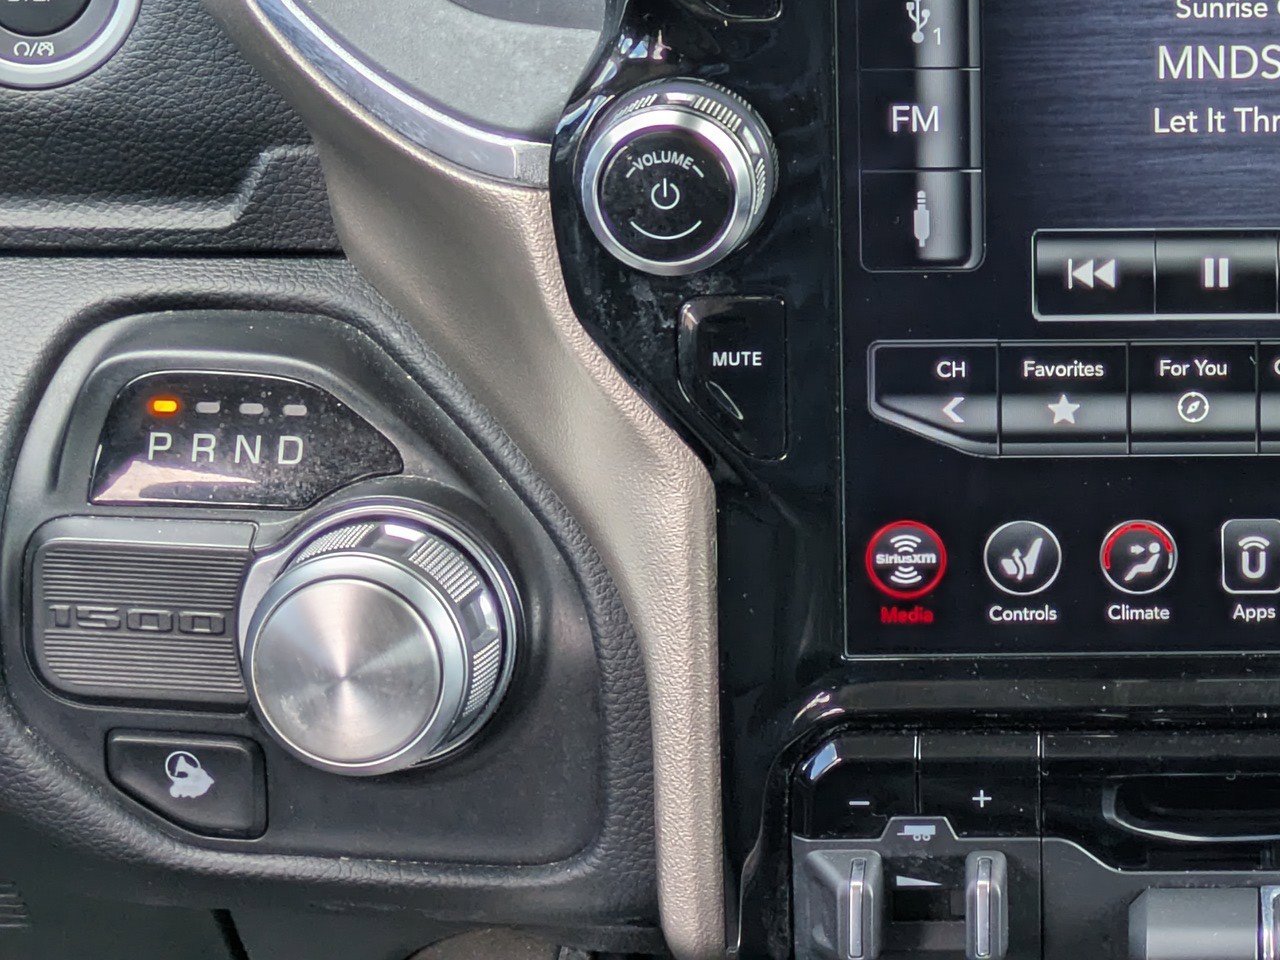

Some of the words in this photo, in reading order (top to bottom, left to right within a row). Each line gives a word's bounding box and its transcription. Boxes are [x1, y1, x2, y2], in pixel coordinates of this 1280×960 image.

[891, 105, 940, 132] FM
[1153, 107, 1198, 133] Let
[1207, 107, 1225, 133] It
[631, 150, 694, 172] VOLUME
[711, 351, 763, 367] MUTE
[1023, 359, 1104, 378] Favorites
[1159, 359, 1190, 377] For
[1194, 359, 1228, 377] You
[936, 360, 966, 379] CH
[148, 432, 173, 460] P
[191, 433, 216, 463] R
[234, 434, 261, 463] N
[277, 435, 304, 464] D
[50, 603, 226, 634] 1500
[880, 608, 934, 623] Media
[989, 605, 1057, 622] Controls
[1107, 604, 1170, 621] Climate
[1232, 604, 1276, 621] Apps
